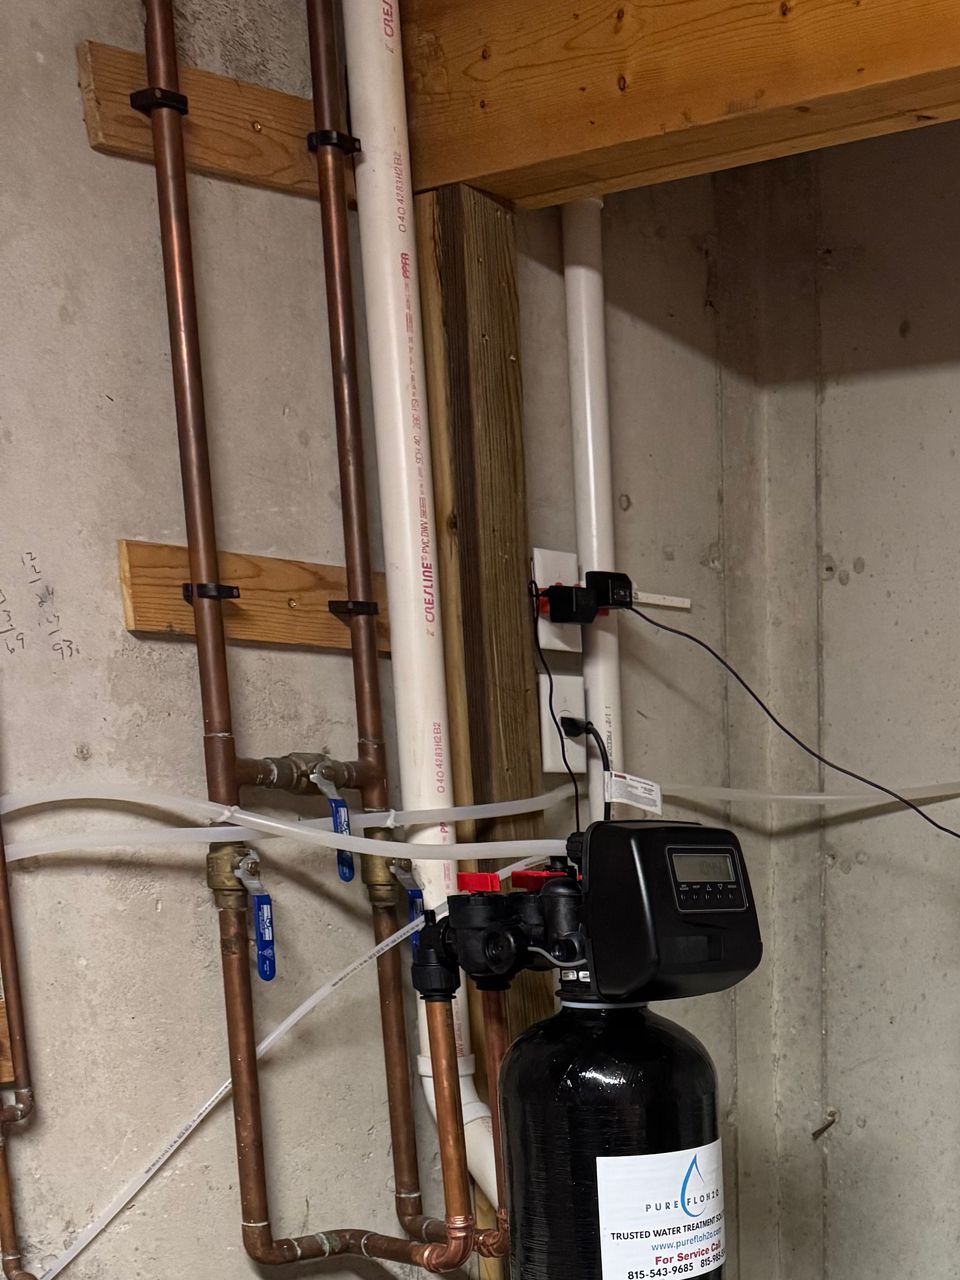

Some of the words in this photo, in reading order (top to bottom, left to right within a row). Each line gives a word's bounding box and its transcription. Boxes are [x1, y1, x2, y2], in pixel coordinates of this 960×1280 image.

[645, 1200, 679, 1212] PURE
[610, 1229, 651, 1241] TRUSTED
[652, 1226, 682, 1238] WATER
[682, 1214, 716, 1233] TREATMENT
[655, 1255, 674, 1266] For
[677, 1247, 709, 1262] Service
[627, 1263, 694, 1280] 815-543-9685
